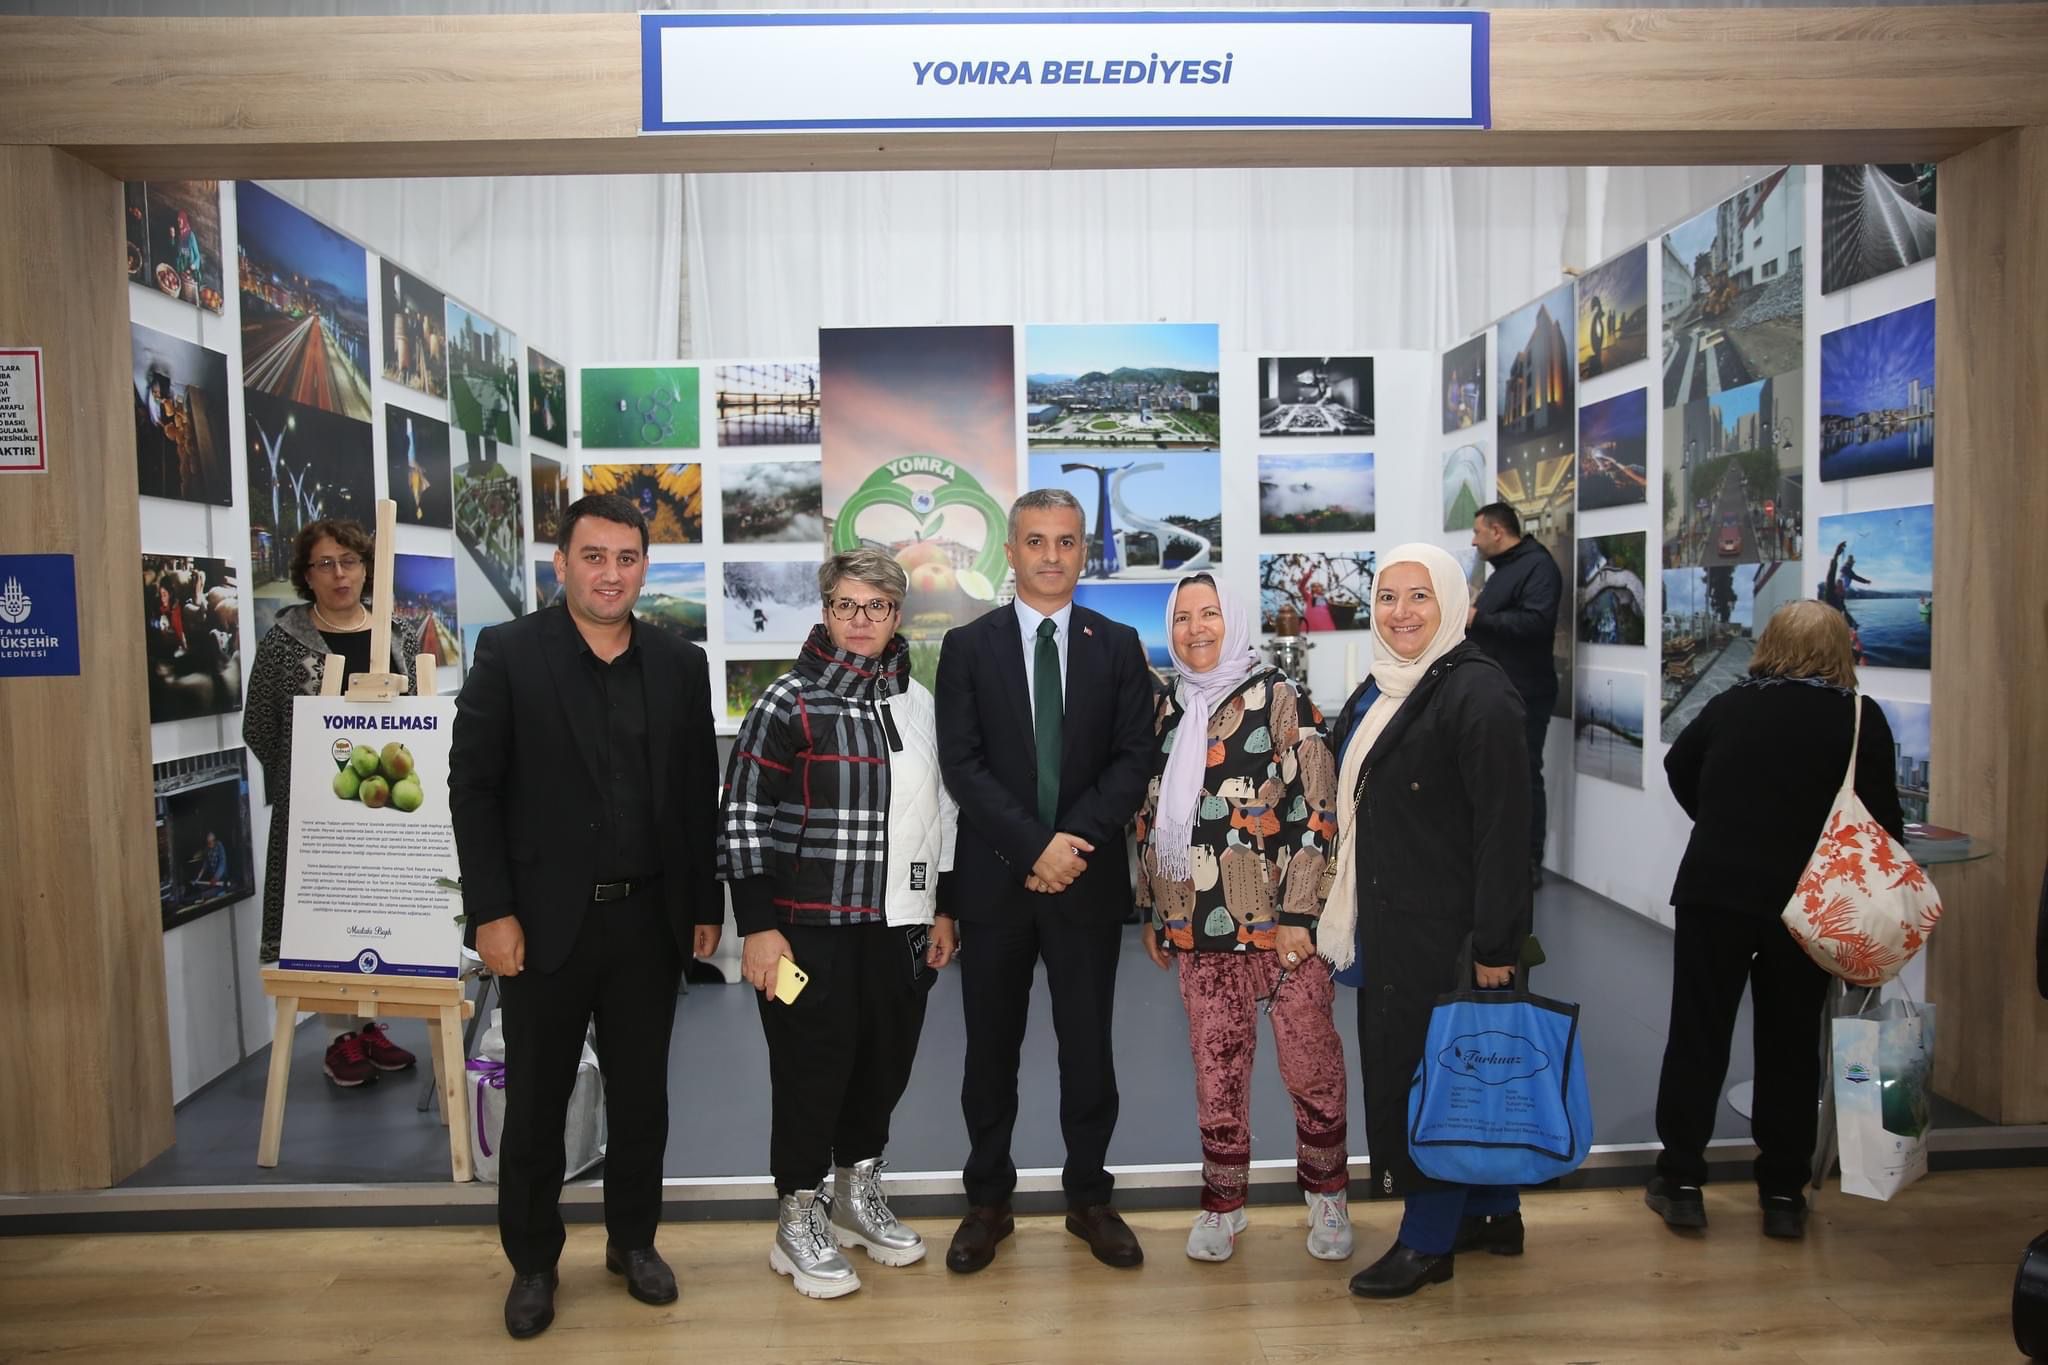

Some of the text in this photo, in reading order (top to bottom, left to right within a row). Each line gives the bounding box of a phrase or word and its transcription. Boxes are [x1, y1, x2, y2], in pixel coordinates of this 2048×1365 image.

[912, 52, 1233, 85] YOMRA BELEDİYESİ
[886, 457, 955, 479] YOMRA
[1, 635, 59, 649] ÜKŞEHİR
[323, 715, 438, 730] YOMRA ELMASI
